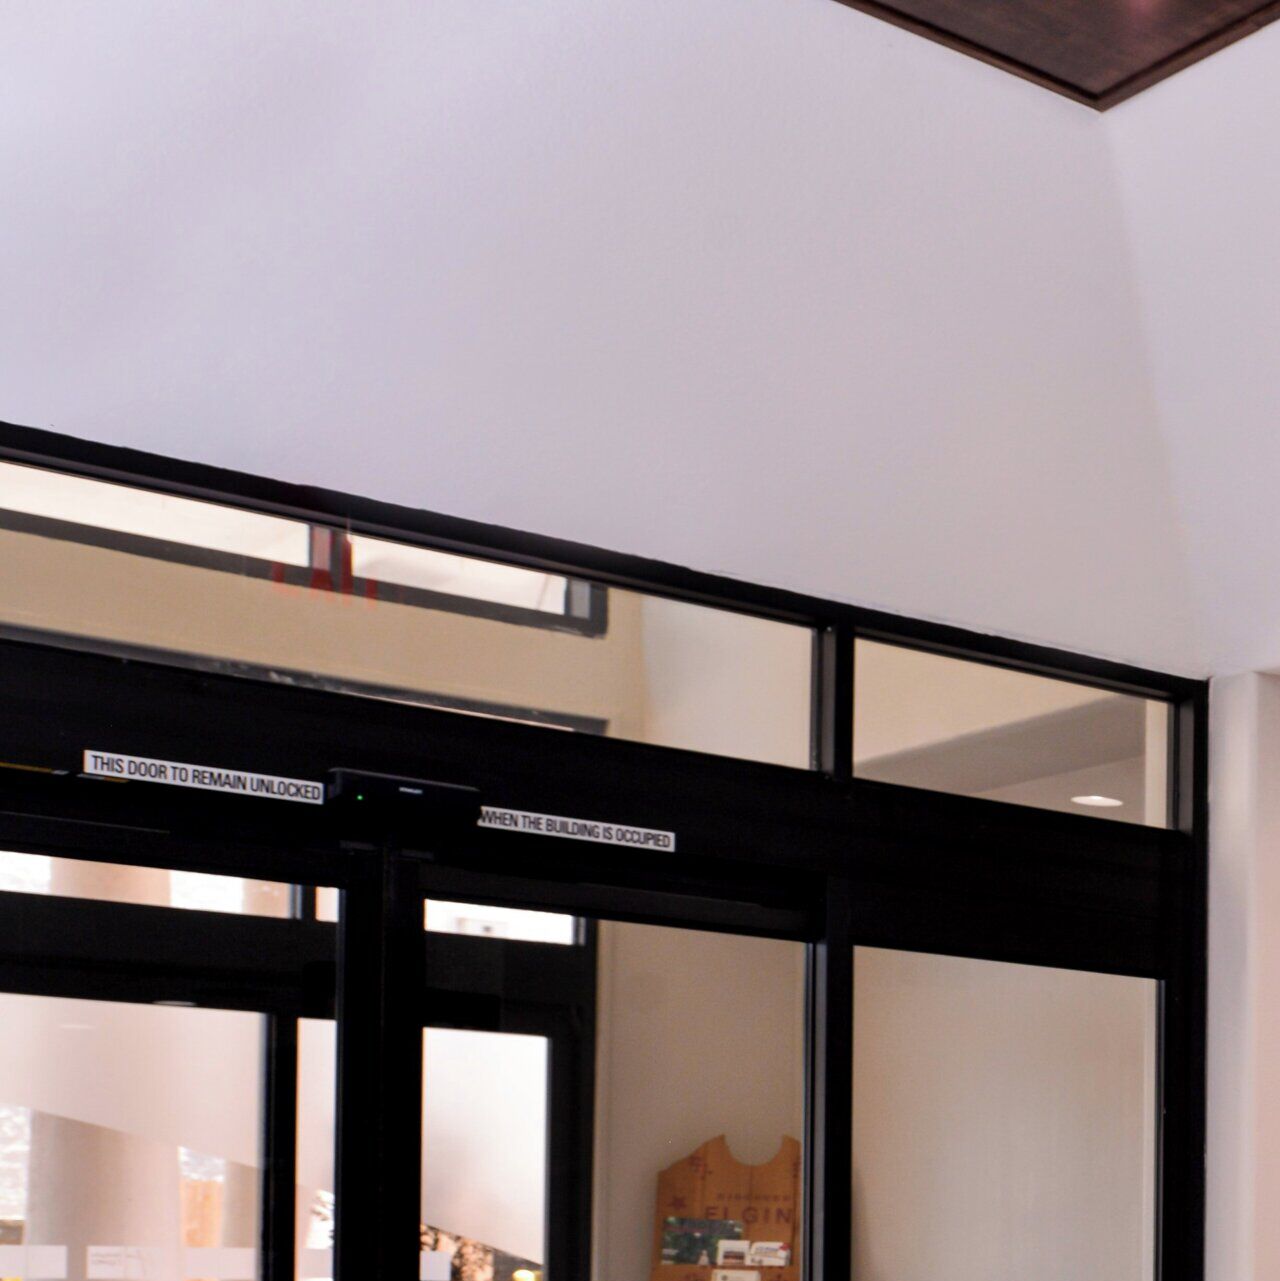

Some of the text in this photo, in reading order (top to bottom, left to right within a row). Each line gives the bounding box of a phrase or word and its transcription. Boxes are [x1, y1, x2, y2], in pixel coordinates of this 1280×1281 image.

[91, 754, 321, 801] THIS DOOR TO REMAIN UNLOCKED
[480, 809, 671, 848] WHEN THE BUILDING IS OCCUPIED
